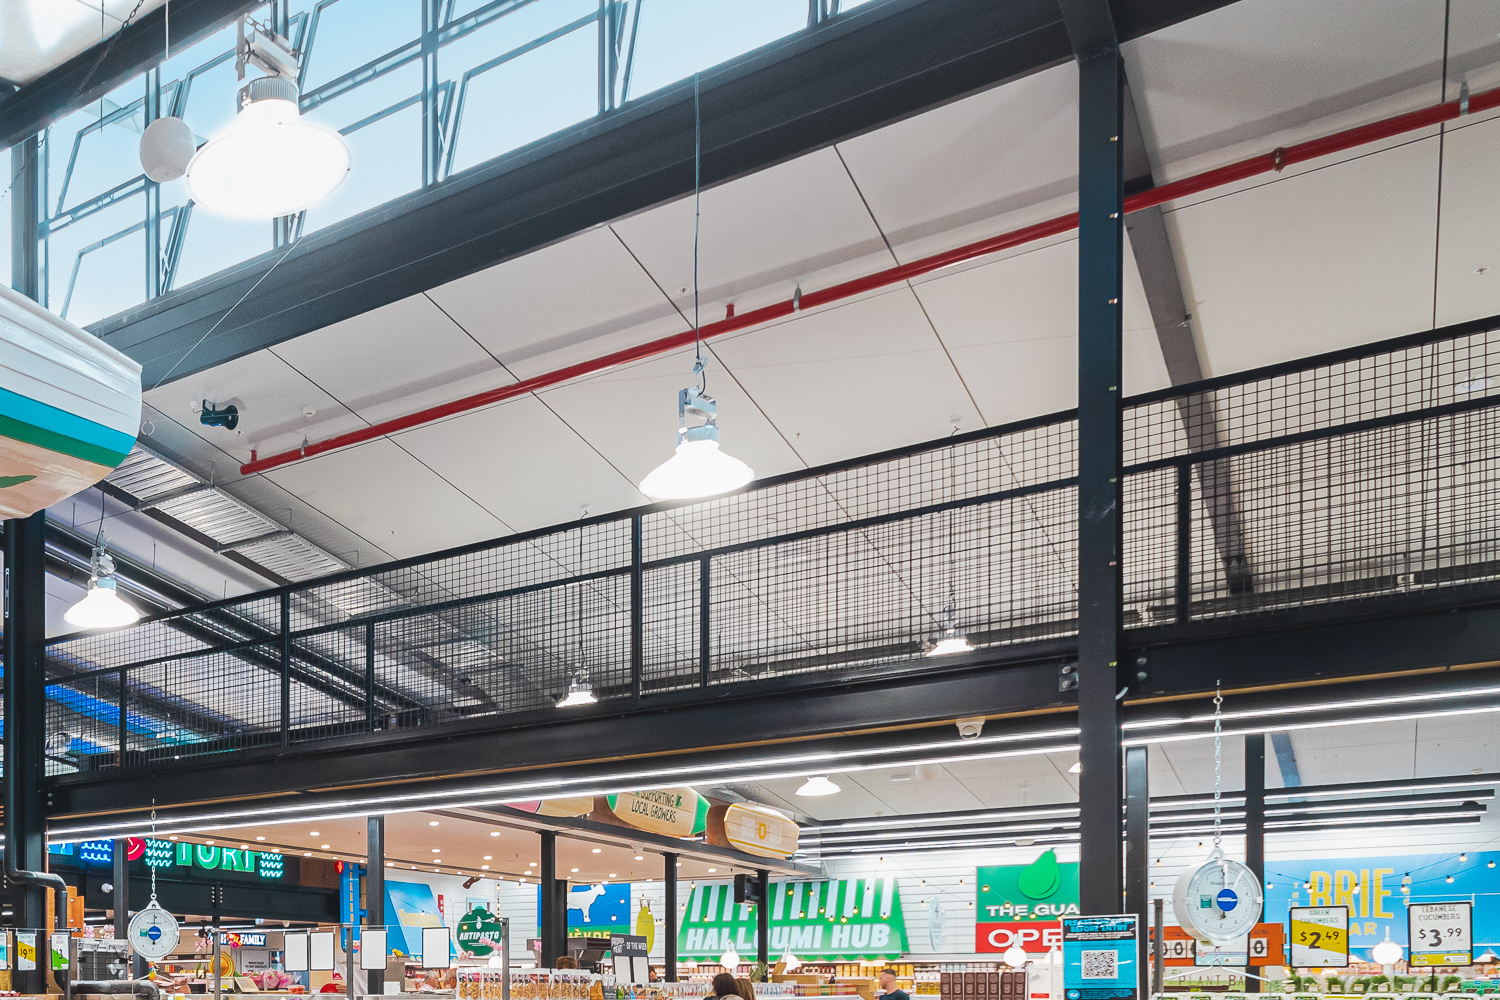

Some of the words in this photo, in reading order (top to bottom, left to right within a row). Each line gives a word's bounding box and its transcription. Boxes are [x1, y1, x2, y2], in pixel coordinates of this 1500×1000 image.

[631, 799, 650, 816] LOCAL
[650, 805, 677, 824] GROWERS
[1309, 868, 1394, 919] BRIE
[985, 904, 1029, 917] THE
[1309, 909, 1330, 917] GREEN
[1421, 904, 1457, 913] LEBANESE
[1300, 916, 1339, 925] CUCUMBERS
[1418, 912, 1461, 921] CUCUMBERS
[1070, 925, 1099, 933] BEFORE
[1101, 924, 1128, 932] ENTRY
[239, 933, 266, 946] FAMILY
[459, 931, 500, 941] ANTIPASTO
[685, 924, 825, 951] HALLUMI
[830, 923, 892, 949] HUB
[1300, 931, 1340, 949] $2.49
[1418, 927, 1462, 947] $3.99
[1179, 974, 1222, 986] PLANT
